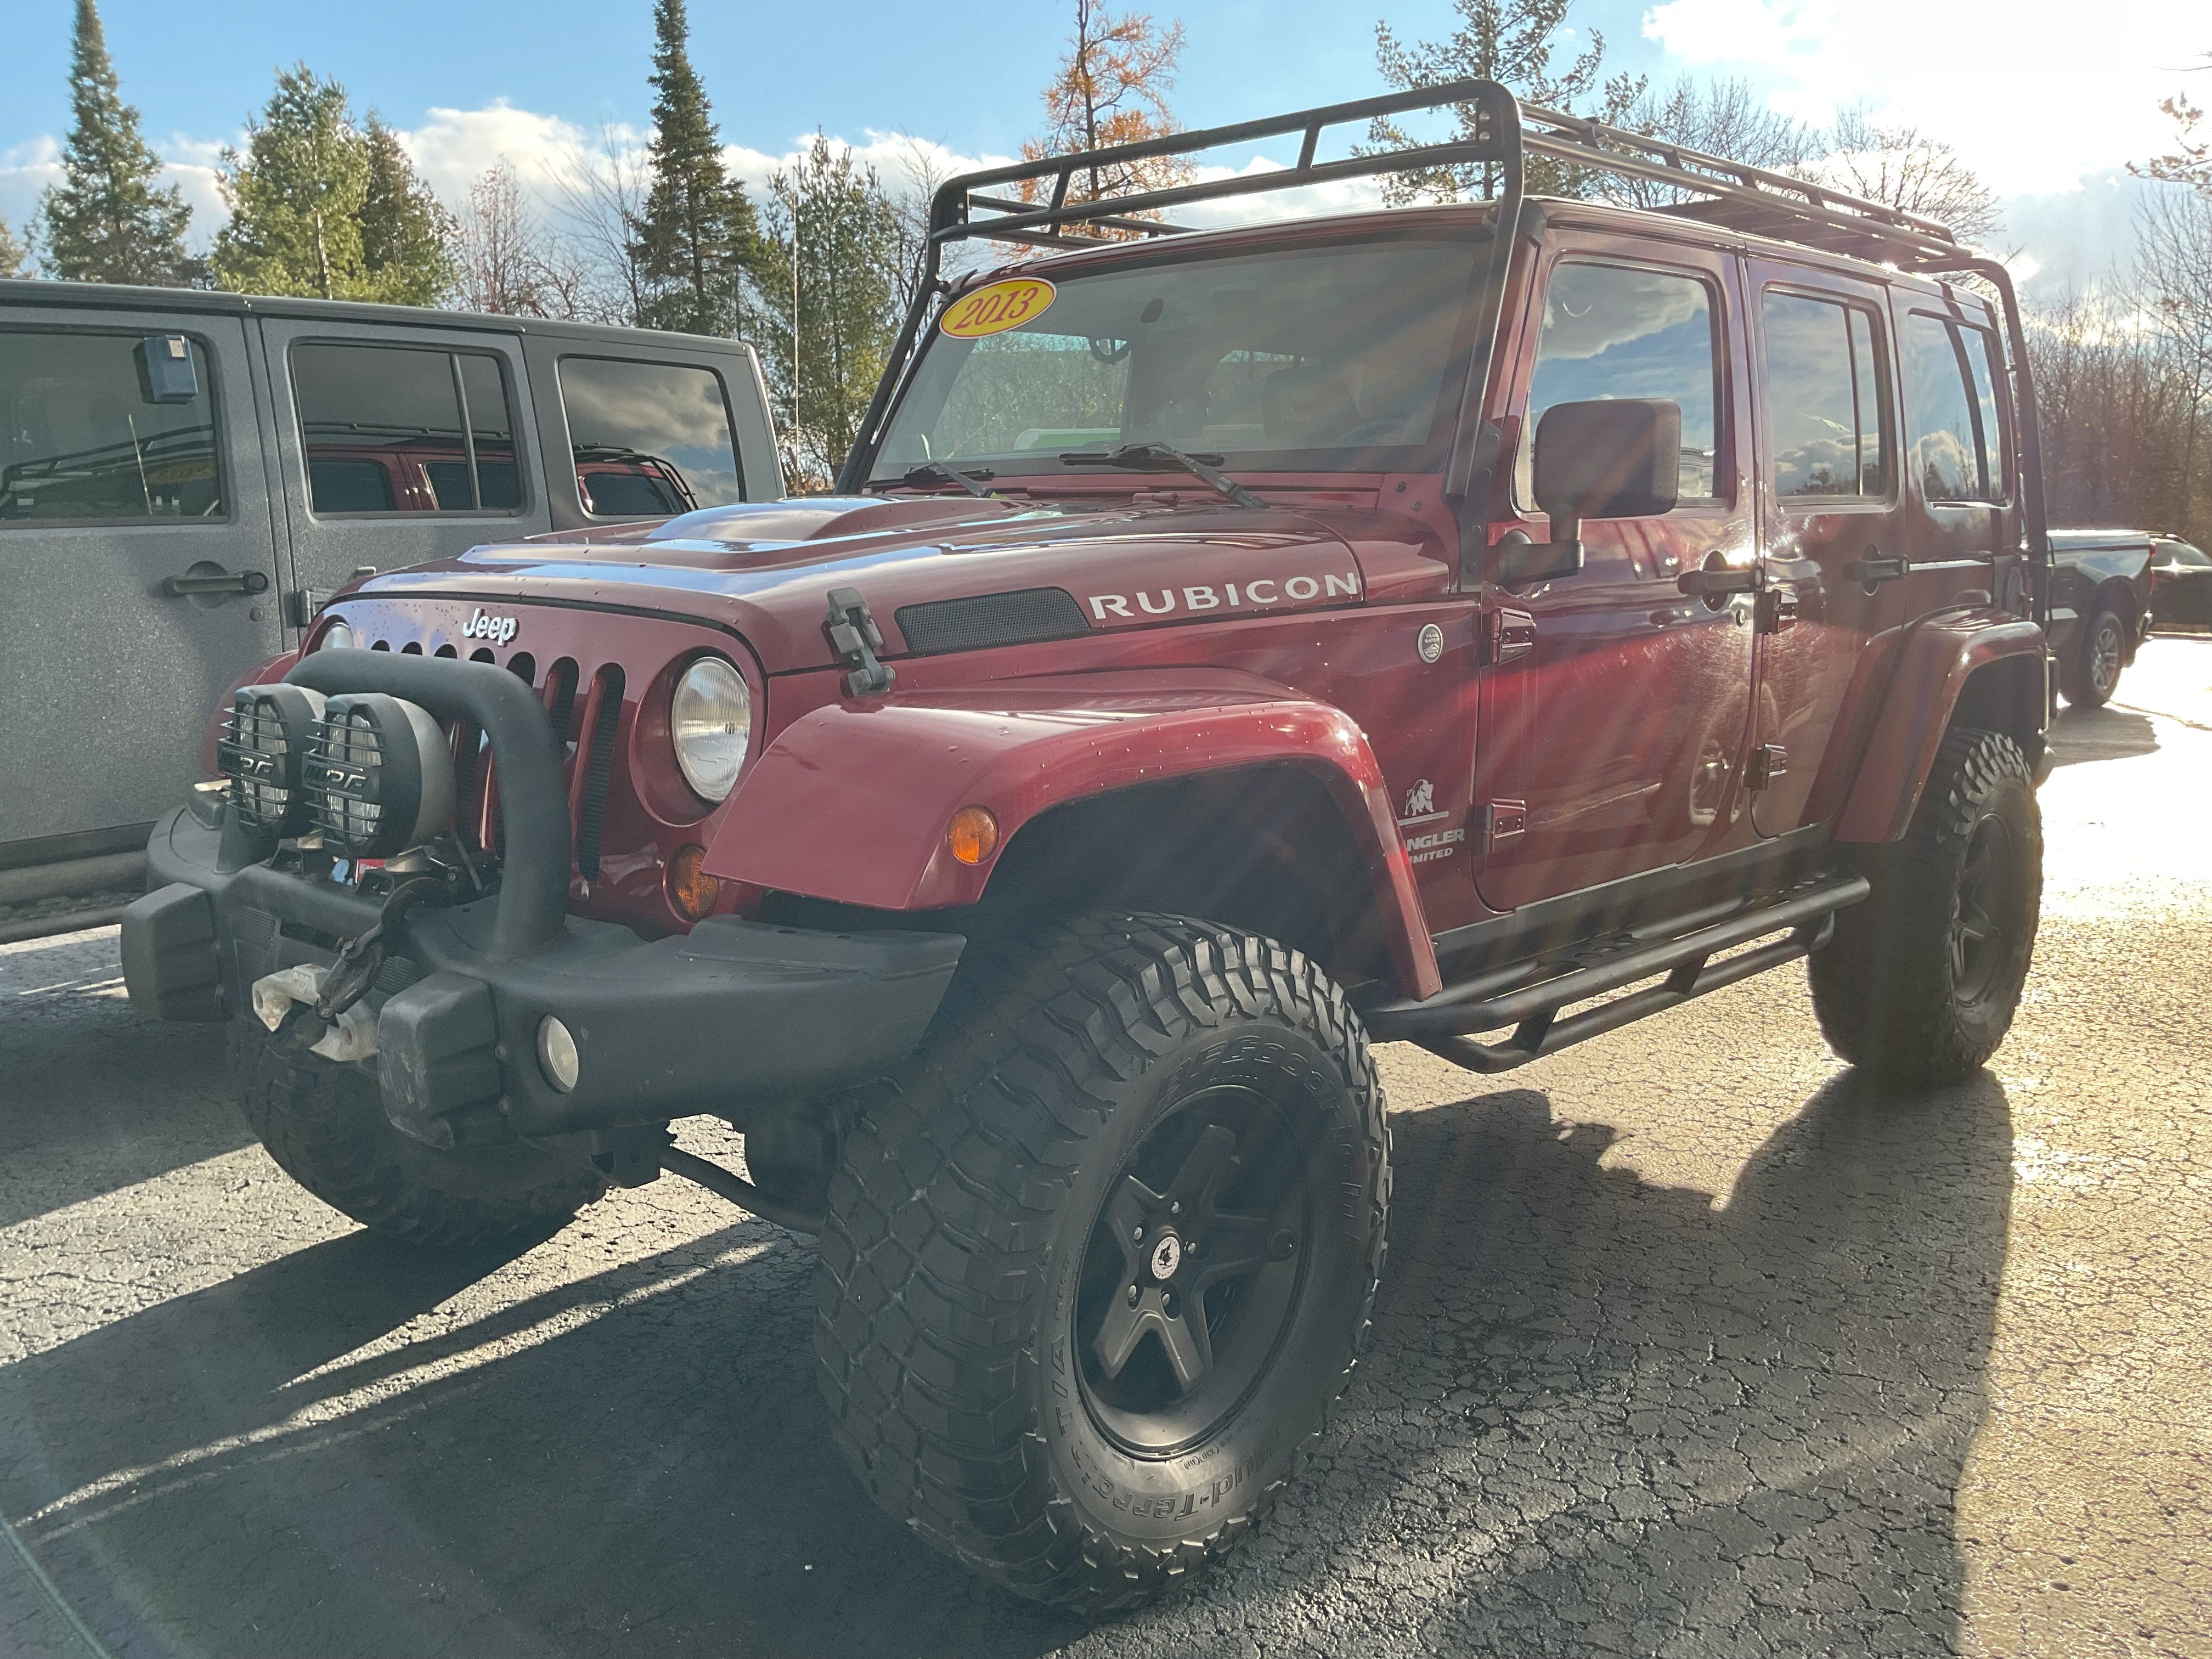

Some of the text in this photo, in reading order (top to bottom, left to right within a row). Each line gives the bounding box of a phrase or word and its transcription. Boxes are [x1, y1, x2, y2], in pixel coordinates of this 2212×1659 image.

[952, 286, 1039, 330] 2013
[1088, 572, 1358, 619] RUBICON
[462, 608, 517, 647] Jeep
[1406, 828, 1465, 851] NGLER
[1409, 847, 1453, 865] IMITED
